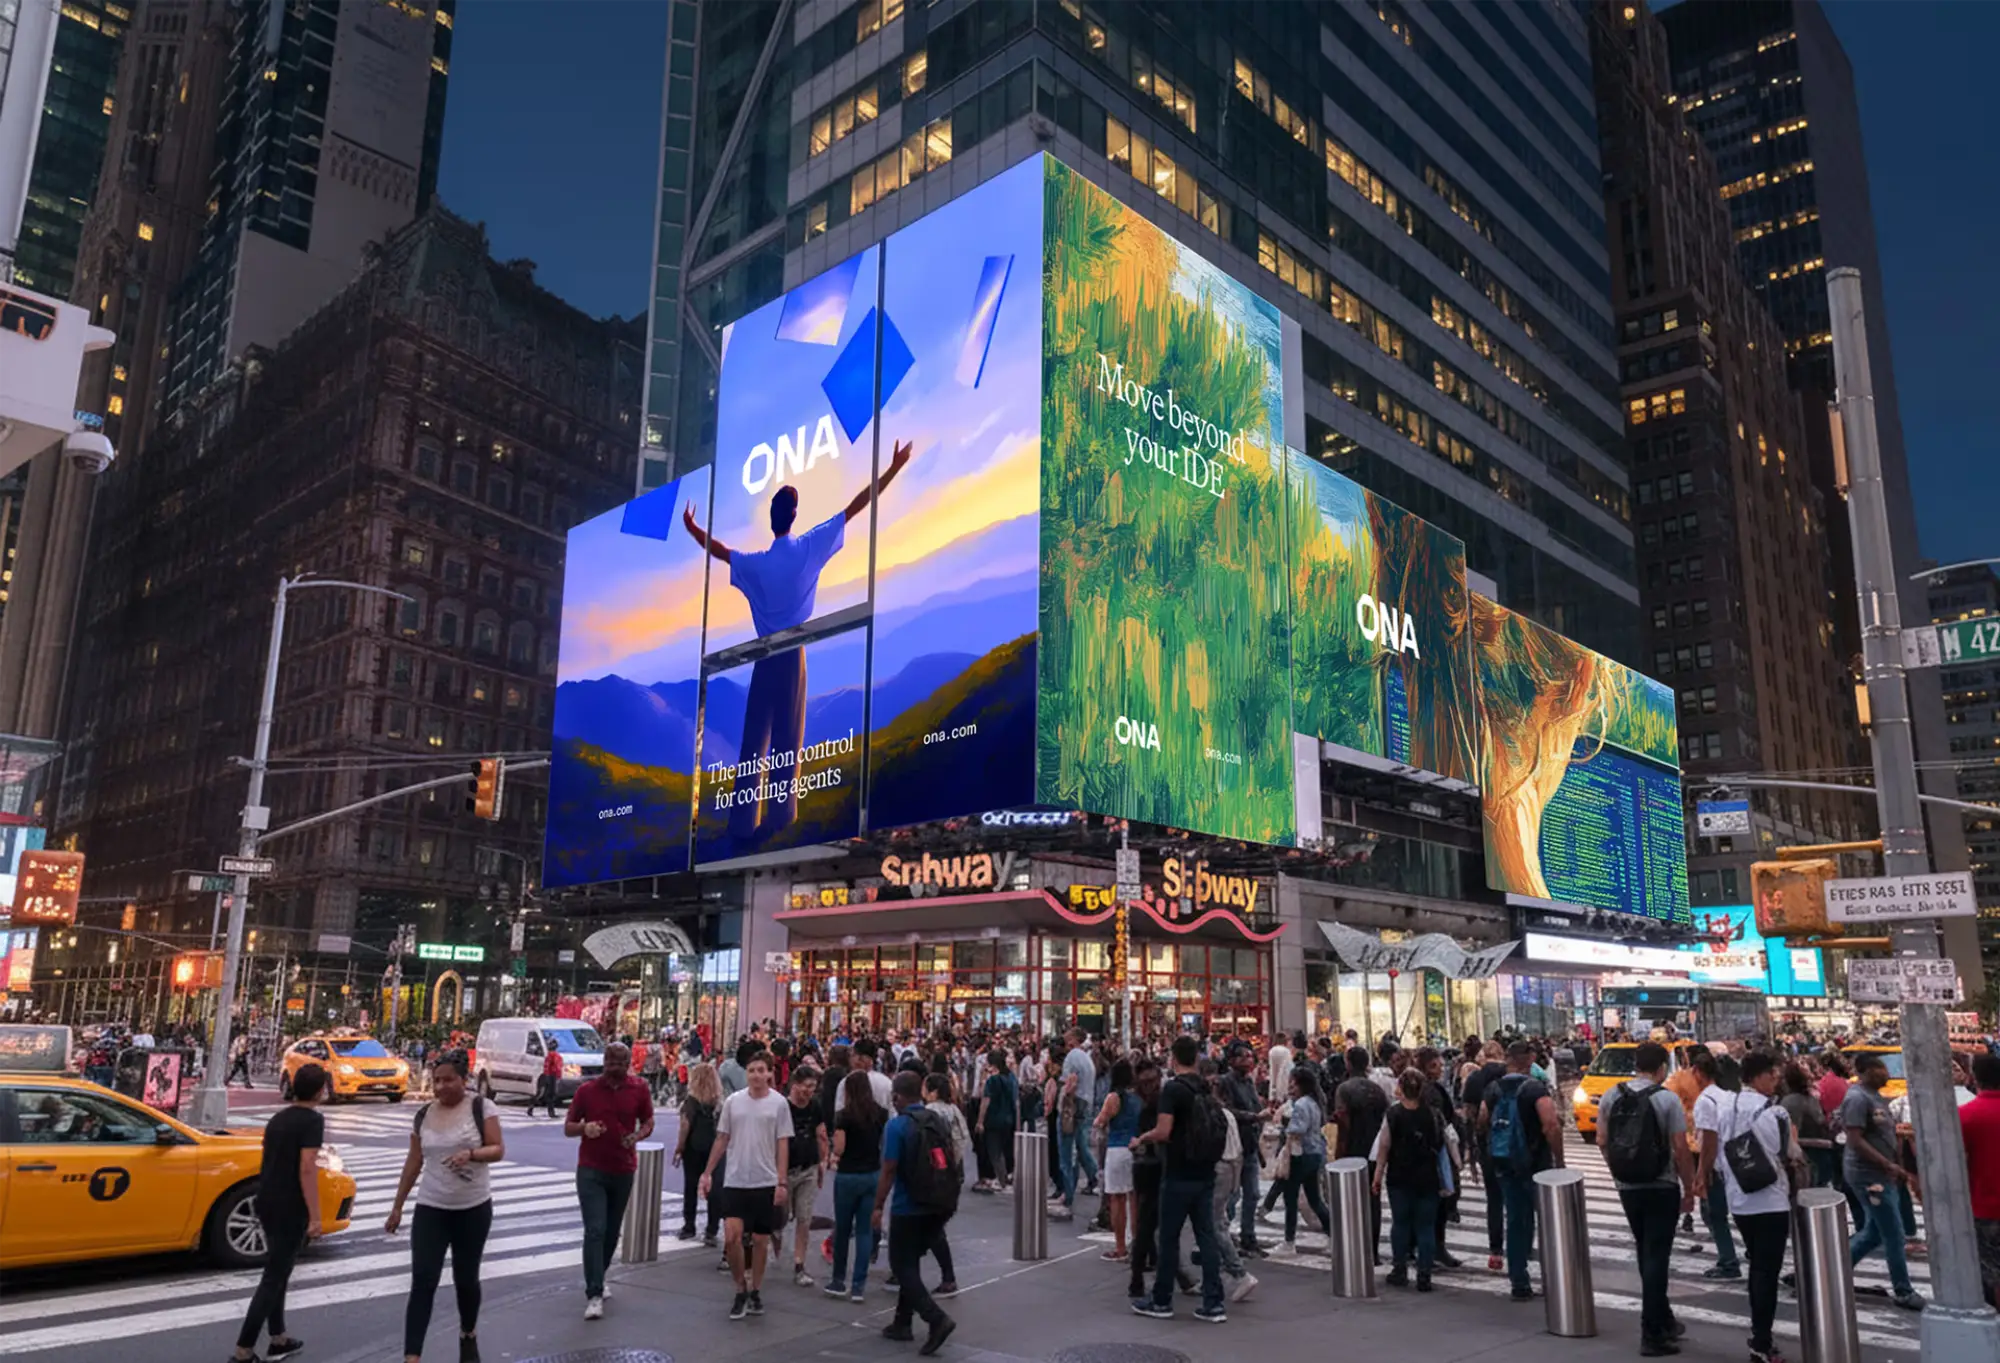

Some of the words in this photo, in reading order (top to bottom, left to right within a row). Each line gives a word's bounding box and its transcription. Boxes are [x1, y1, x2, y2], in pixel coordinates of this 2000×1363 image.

[1097, 354, 1165, 421] Move
[1167, 389, 1246, 464] beyond
[742, 414, 840, 495] ONA
[1124, 427, 1179, 476] your
[1181, 445, 1225, 499] IDE
[1356, 593, 1421, 660] ONA
[707, 760, 737, 785] The
[736, 748, 795, 778] mission
[796, 728, 854, 764] control
[923, 723, 977, 745] ona.com
[1115, 715, 1161, 752] ONA
[1205, 747, 1242, 766] ona.com
[598, 804, 633, 820] ona.com
[714, 787, 737, 810] for
[737, 777, 789, 803] coding
[789, 767, 842, 799] agents
